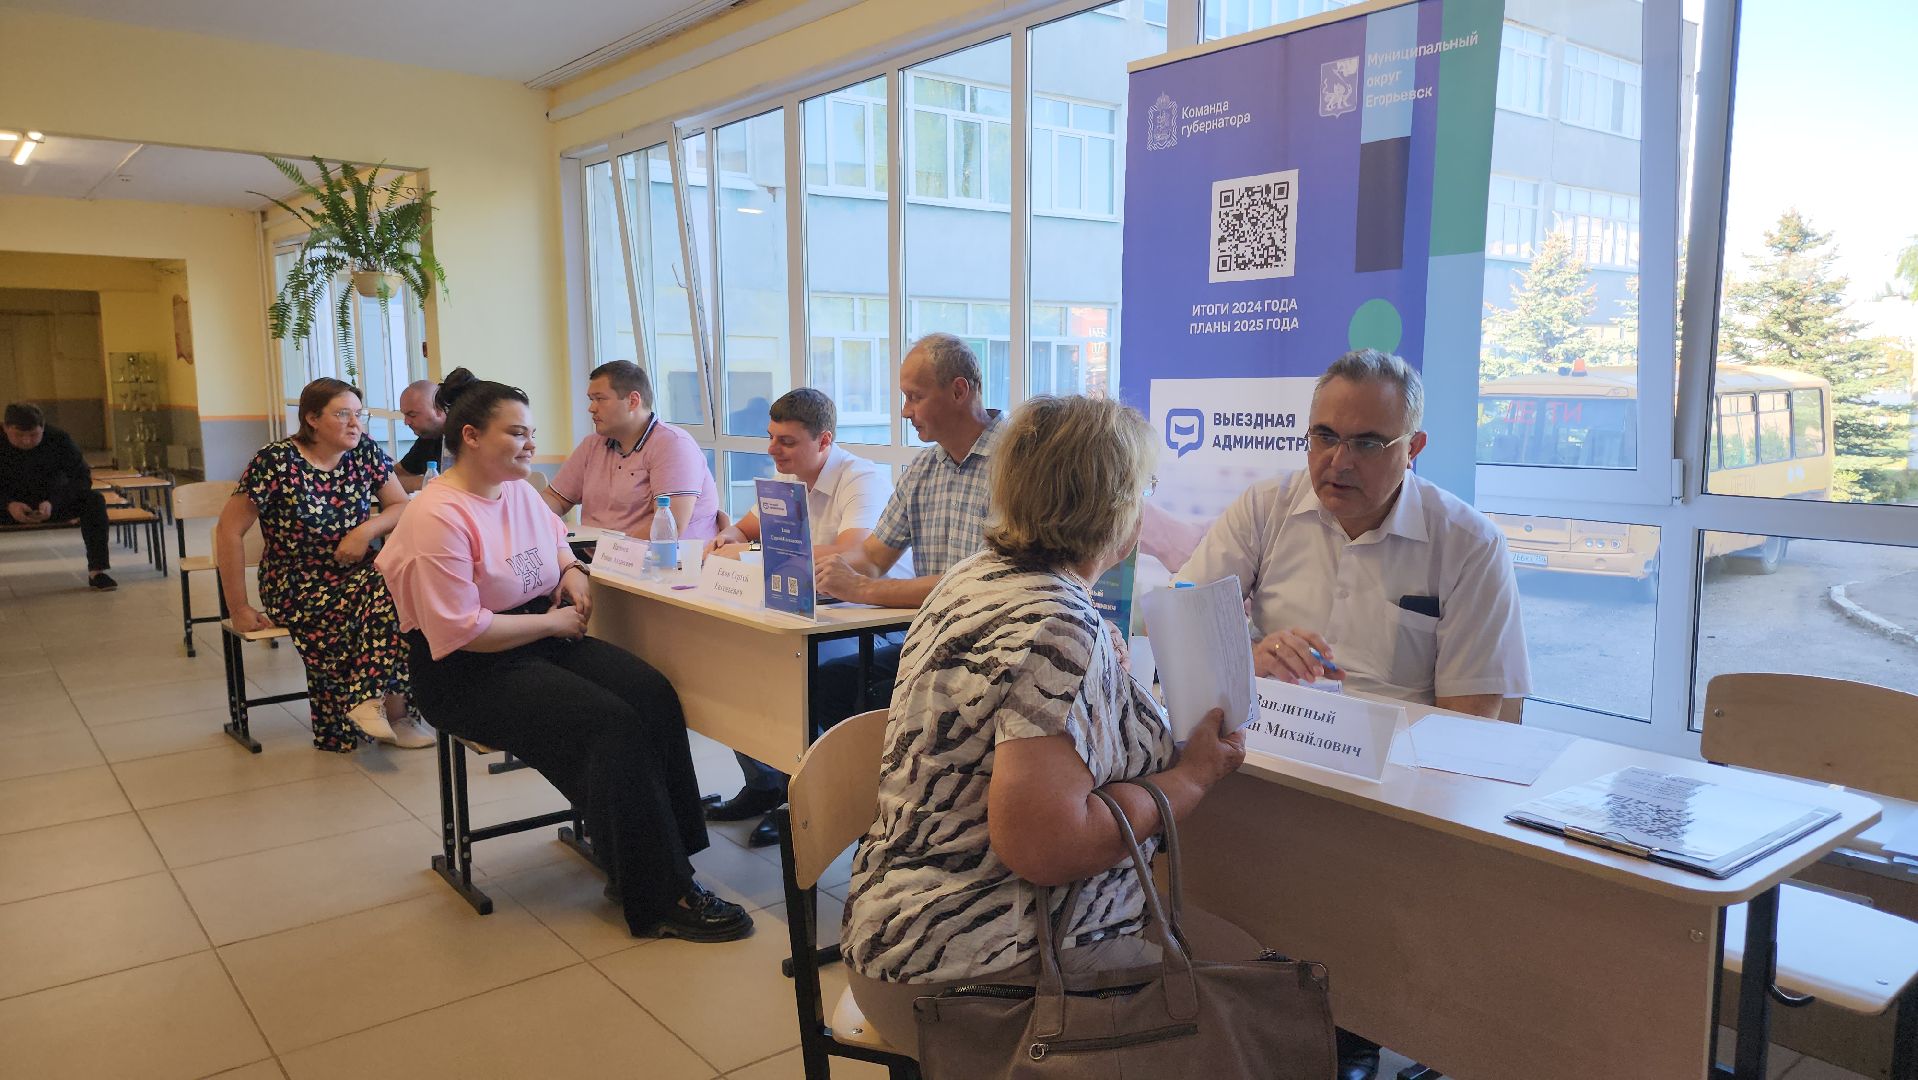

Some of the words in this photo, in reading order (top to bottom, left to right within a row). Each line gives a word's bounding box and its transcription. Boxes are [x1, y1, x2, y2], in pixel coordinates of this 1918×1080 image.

[1367, 30, 1479, 66] Муниципальный
[1366, 69, 1403, 90] округ
[1365, 86, 1433, 108] Егорьевск
[1181, 100, 1230, 120] Команда
[1181, 112, 1251, 136] губернатора
[1192, 301, 1230, 317] ИТОГИ
[1231, 300, 1262, 315] 2024
[1264, 298, 1298, 313] ГОДА
[1189, 319, 1231, 335] ПЛАНЫ
[1233, 318, 1264, 333] 2025
[1266, 317, 1299, 332] ГОДА
[1213, 412, 1296, 429] ВЫЕЗДНАЯ
[1265, 721, 1362, 758] Михайлович
